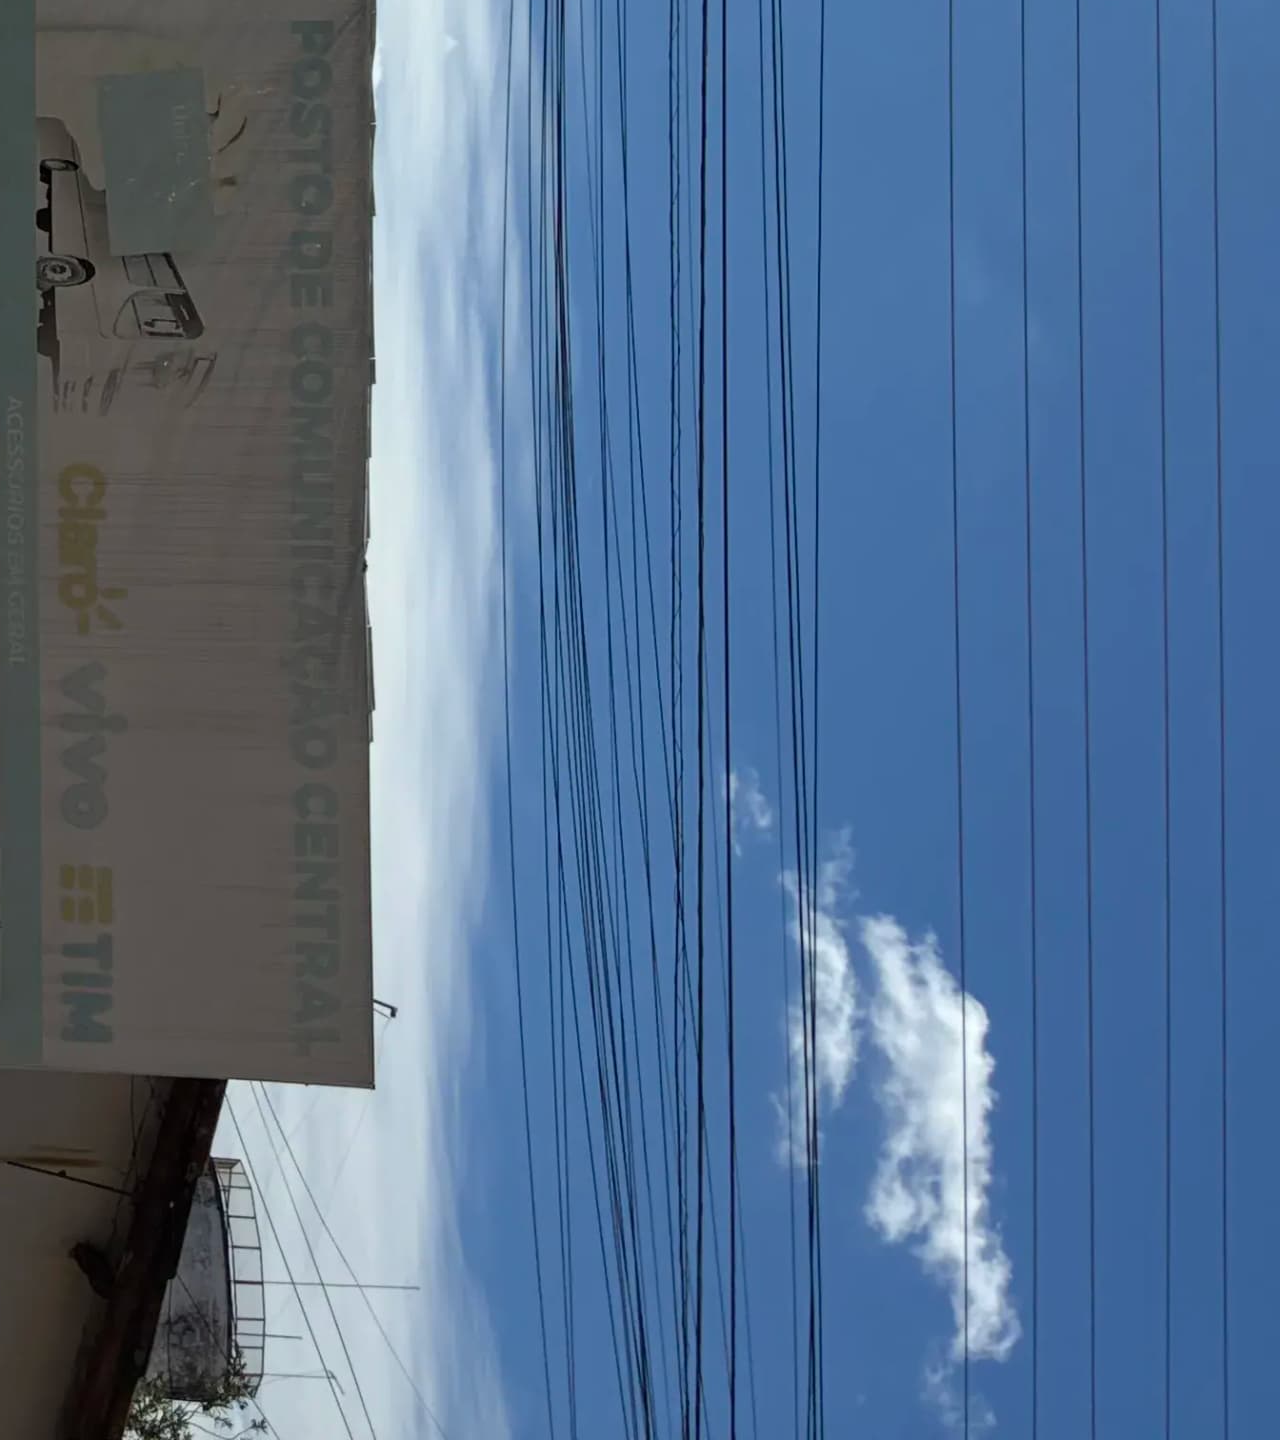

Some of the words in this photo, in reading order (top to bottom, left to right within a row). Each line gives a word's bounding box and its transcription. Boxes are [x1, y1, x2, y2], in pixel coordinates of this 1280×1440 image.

[290, 19, 334, 216] POSTO
[290, 230, 333, 307] DE
[60, 933, 113, 1045] TIM
[292, 783, 342, 1058] CENTRAL
